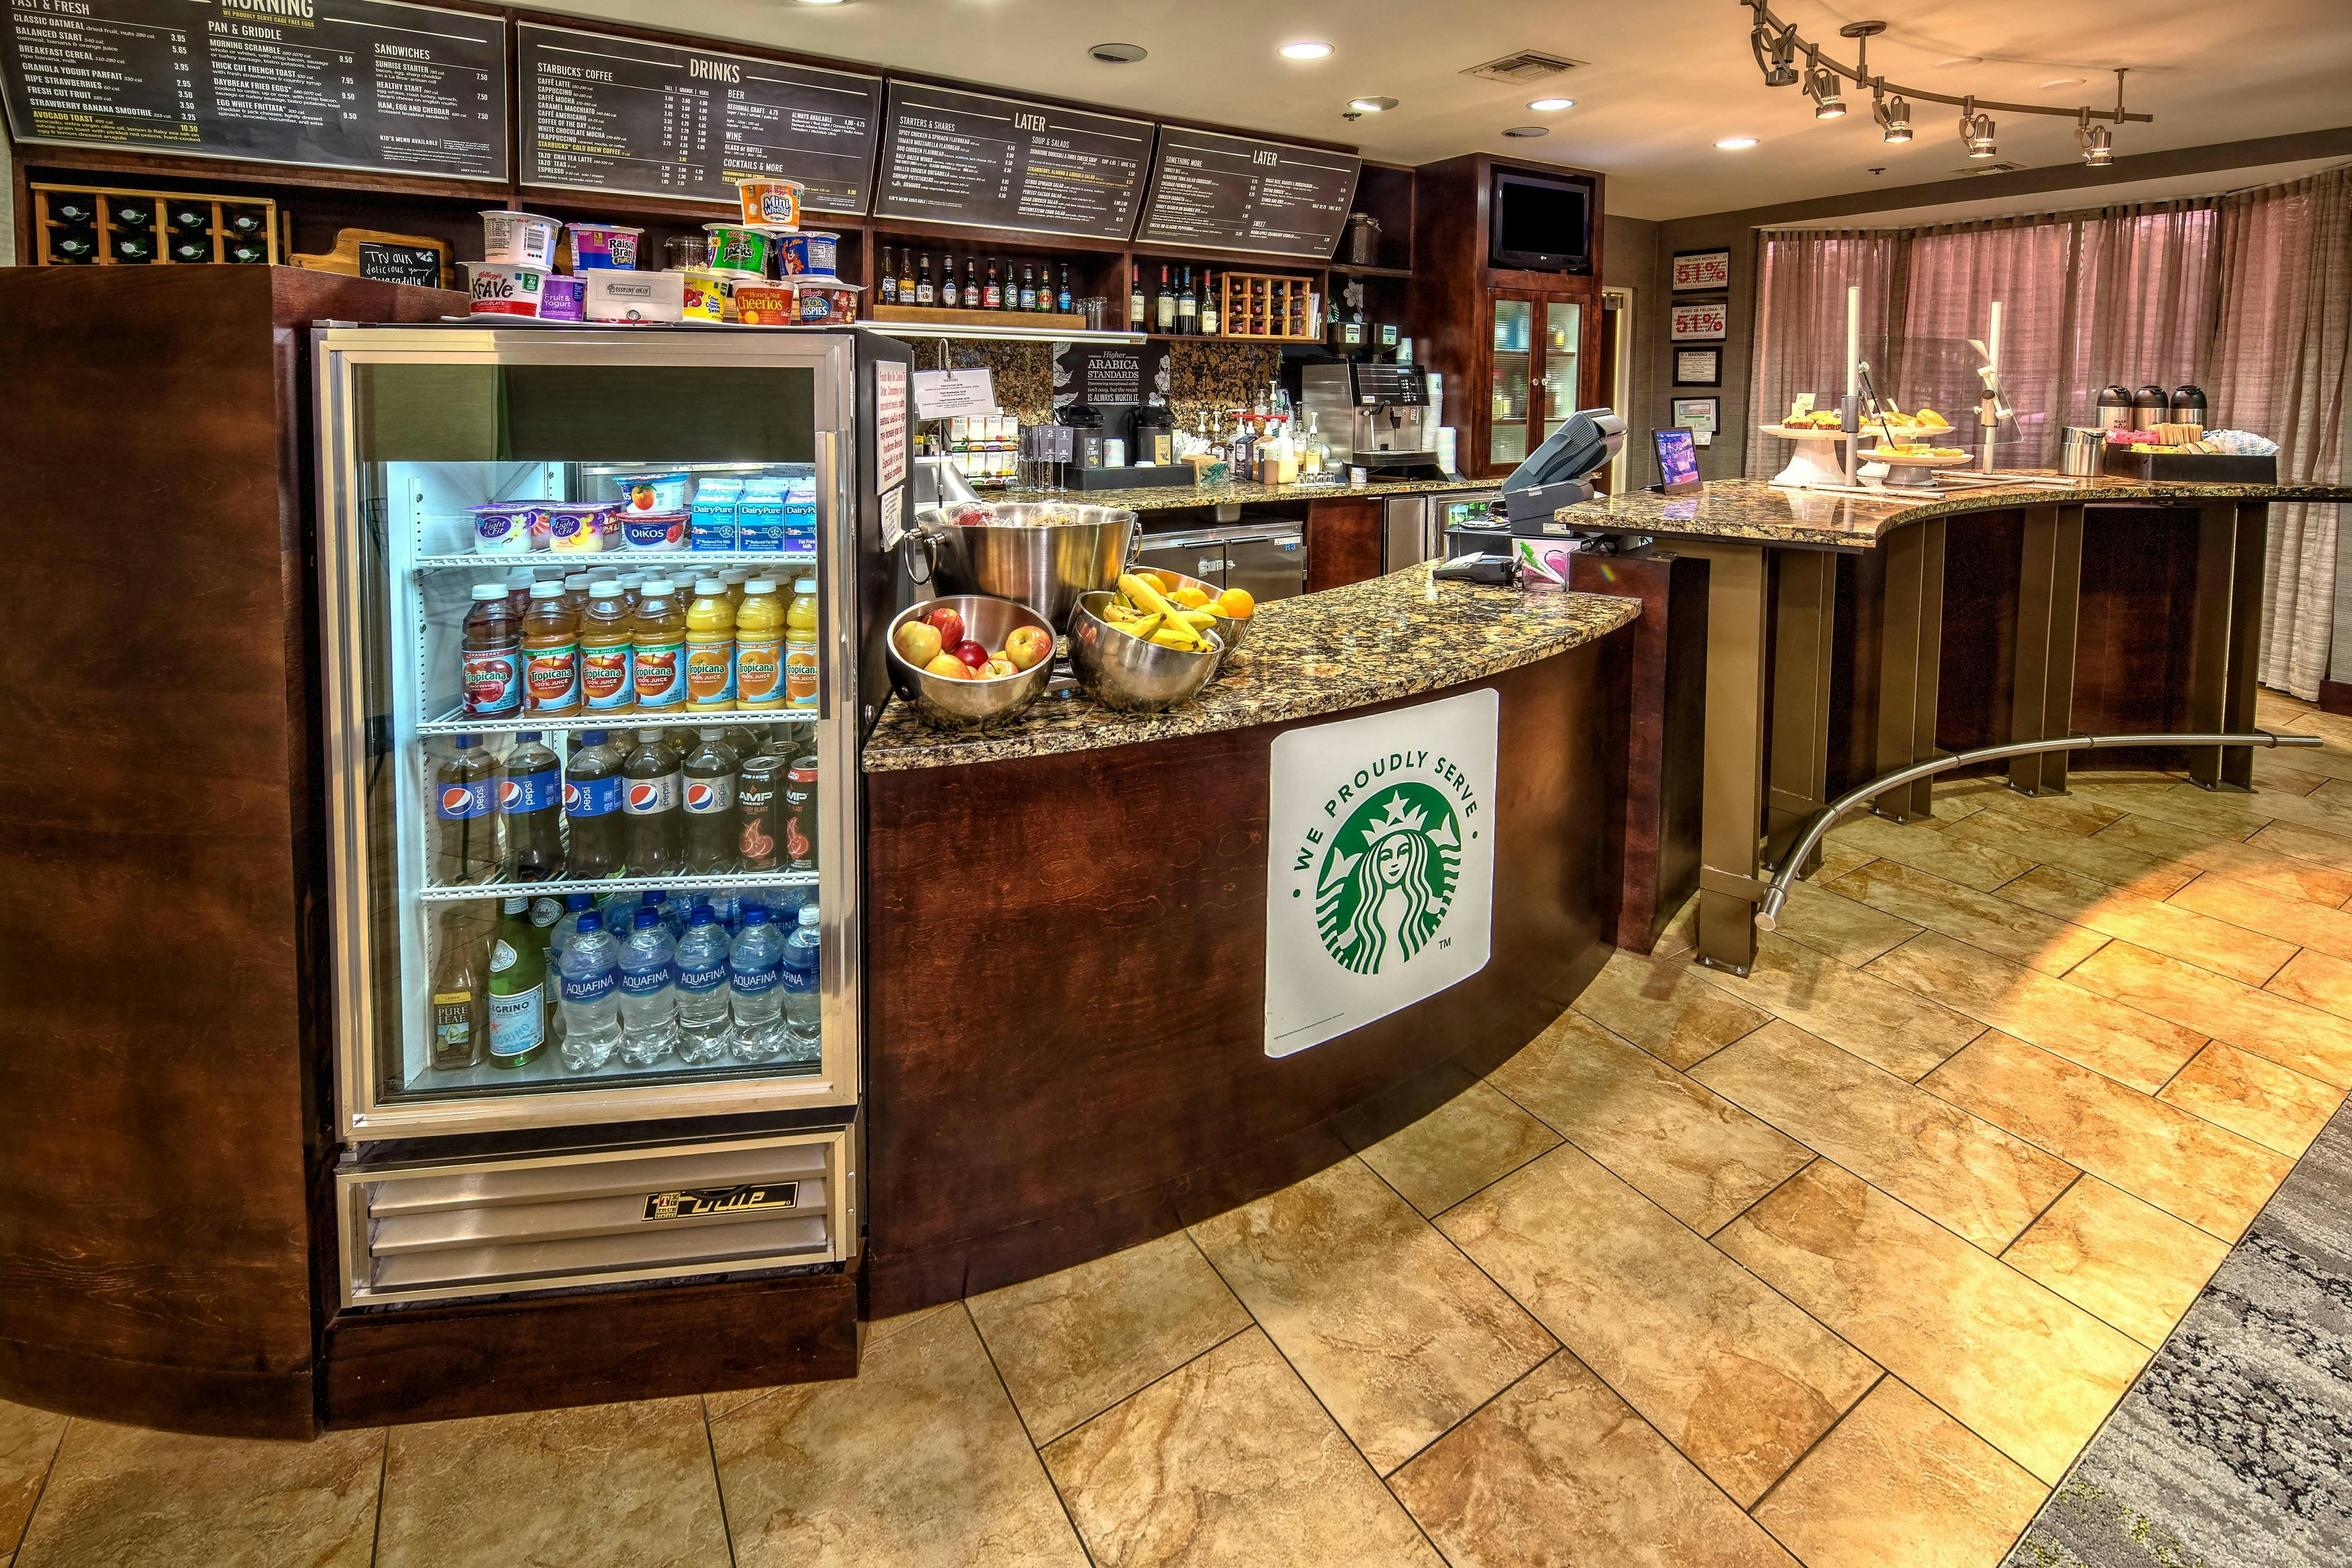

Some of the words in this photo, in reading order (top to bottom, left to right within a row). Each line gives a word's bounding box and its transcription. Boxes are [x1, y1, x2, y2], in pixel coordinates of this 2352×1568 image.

[55, 0, 89, 15] FRESH
[14, 14, 47, 25] CLASSIC
[49, 19, 85, 29] OATMEAL
[171, 34, 186, 42] 3.95
[208, 21, 228, 33] PAN
[232, 24, 238, 35] &
[242, 25, 282, 40] GRIDDLE
[375, 44, 430, 59] SANDWICHES
[248, 66, 274, 75] FRENCH
[276, 69, 296, 78] TOAST
[376, 60, 402, 69] SUNRISE
[403, 64, 428, 73] STARTER
[690, 58, 740, 83] DRINKS
[586, 69, 613, 81] COFFEE
[538, 86, 572, 96] CAPPUCCINO
[728, 89, 744, 99] BEER
[30, 98, 81, 109] STRAWBERRY
[83, 103, 113, 113] BANANA
[115, 107, 152, 116] SMOOTHIE
[34, 111, 68, 120] AVOCADO
[70, 114, 93, 122] TOAST
[1014, 112, 1045, 132] LATER
[900, 116, 927, 127] STARTERS
[934, 122, 956, 132] SHARES
[538, 133, 577, 143] FRAPPUCCINO
[726, 131, 742, 141] WINE
[950, 136, 970, 145] FLATBREAD
[1032, 136, 1045, 145] SOUP
[1051, 139, 1070, 149] SALADS
[1165, 155, 1190, 165] SOMETHING
[1253, 150, 1278, 166] LATER
[723, 159, 757, 170] COCKTAILS
[766, 164, 783, 172] MORE
[764, 196, 789, 208] Mini
[764, 206, 790, 216] Wheats
[609, 239, 634, 252] Raisin
[365, 252, 389, 263] Try
[613, 248, 632, 259] Bran
[723, 248, 753, 262] JACKS
[366, 263, 403, 275] delicious
[1676, 262, 1726, 283] 51%
[544, 299, 570, 308] Yogurt
[737, 296, 783, 310] Cheerios
[802, 299, 823, 307] COCOA
[800, 306, 828, 317] KRISPIES
[1676, 314, 1723, 333] 51%
[1103, 351, 1125, 359] Higher
[1087, 359, 1139, 369] ARABICA
[1087, 370, 1138, 379] STANDARDS
[1088, 393, 1093, 402] IS
[1094, 393, 1114, 402] ALWAYS
[693, 506, 733, 514] DairyPure
[741, 506, 781, 515] DairyPure
[484, 520, 506, 530] Light
[556, 519, 574, 529] Light
[632, 529, 664, 538] OIKOS
[584, 669, 622, 678] Tropicana
[634, 667, 671, 677] Tropicana
[688, 664, 724, 674] Tropicana
[739, 664, 774, 673] Tropicana
[465, 671, 507, 684] Tropicana
[530, 669, 572, 682] Tropicana
[475, 785, 485, 810] pepsi
[523, 780, 535, 805] pepsi
[582, 786, 592, 811] pepsi
[662, 782, 670, 805] pepsi
[739, 792, 772, 802] AMP
[1294, 827, 1324, 872] WE
[1324, 750, 1429, 819] PROUDLY
[1434, 757, 1478, 818] SERVE
[1438, 937, 1452, 950] TM
[623, 968, 669, 988] AQUAFINA
[681, 965, 726, 984] AQUAFINA
[733, 969, 777, 987] AQUAFINA
[566, 974, 614, 994] AQUAFINA
[438, 1006, 468, 1017] PURE
[439, 1014, 466, 1024] LEAF
